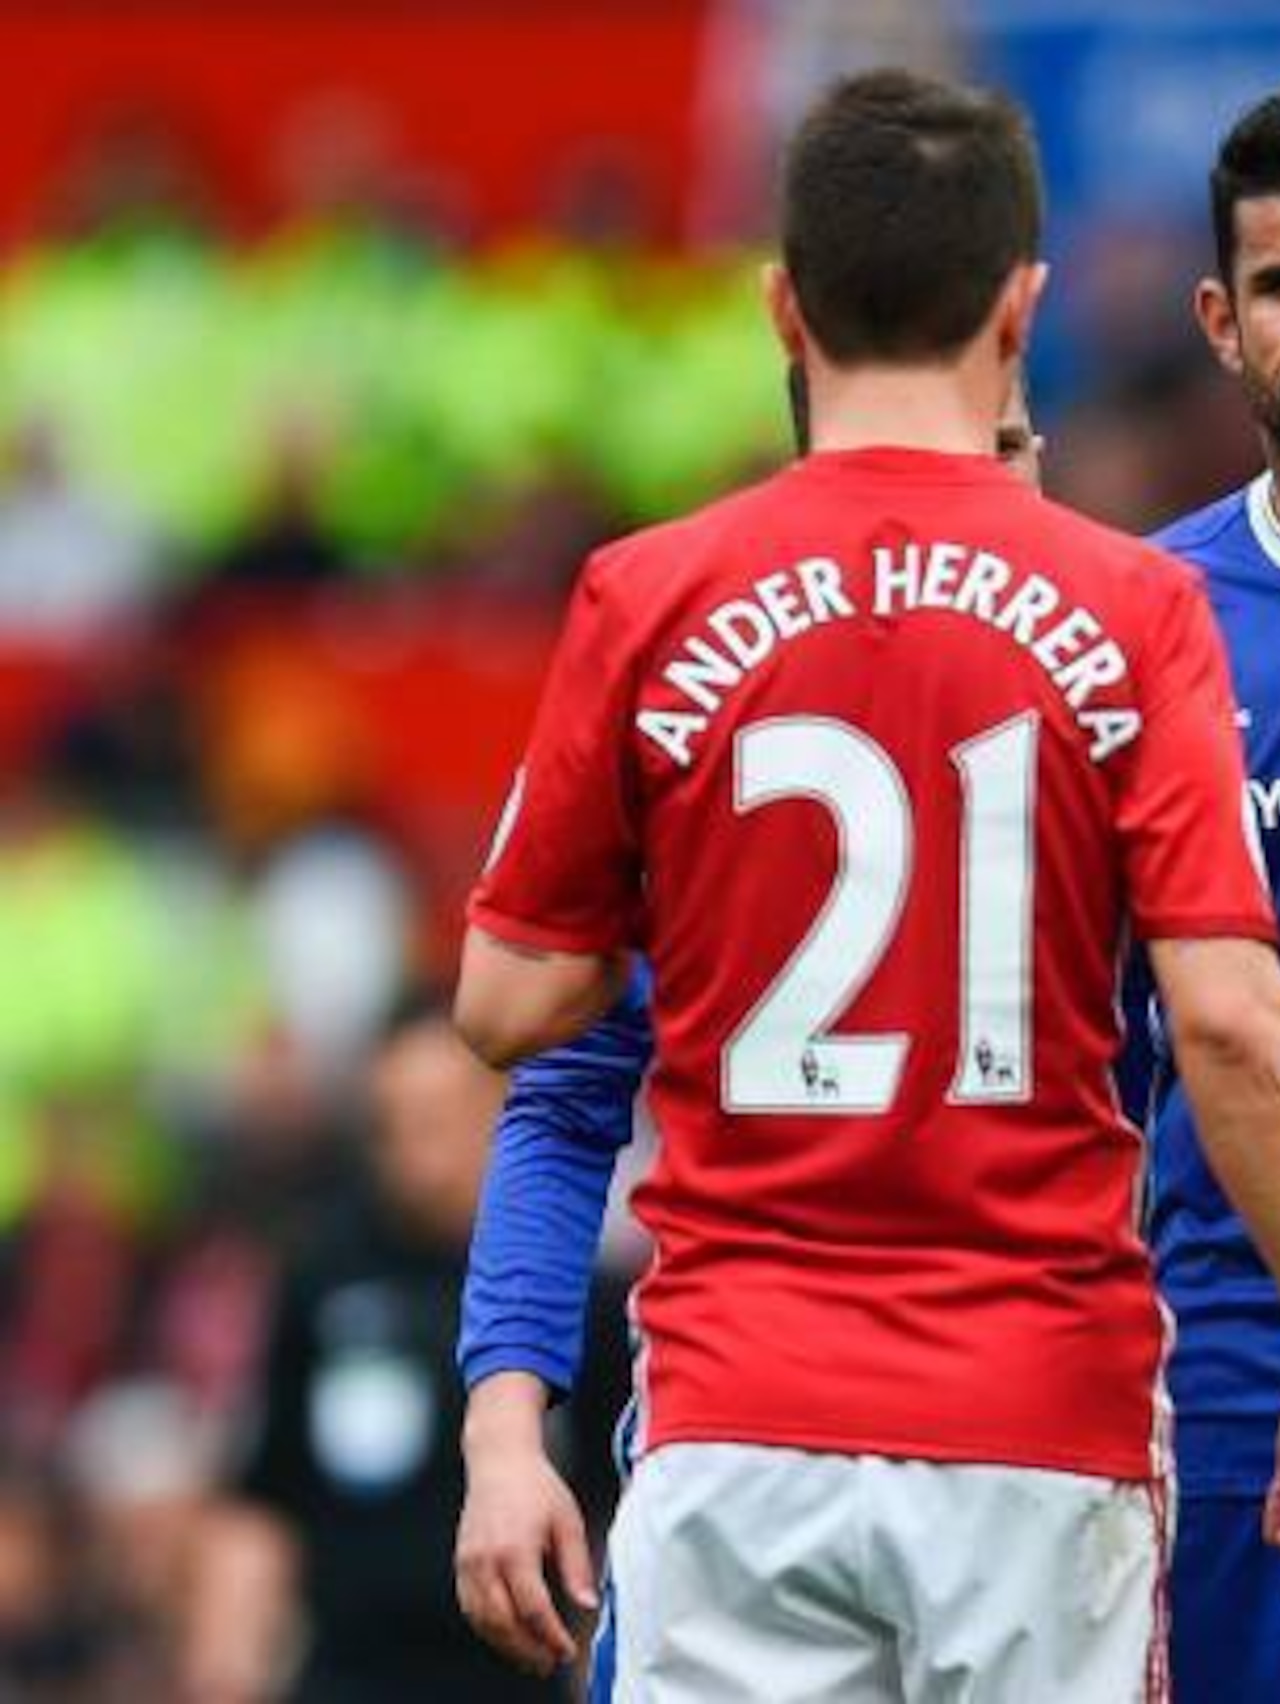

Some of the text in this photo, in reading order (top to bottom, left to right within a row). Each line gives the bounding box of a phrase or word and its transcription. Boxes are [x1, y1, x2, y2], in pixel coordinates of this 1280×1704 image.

[636, 543, 1142, 766] ANDER HERRERA
[720, 707, 1041, 1115] 21
